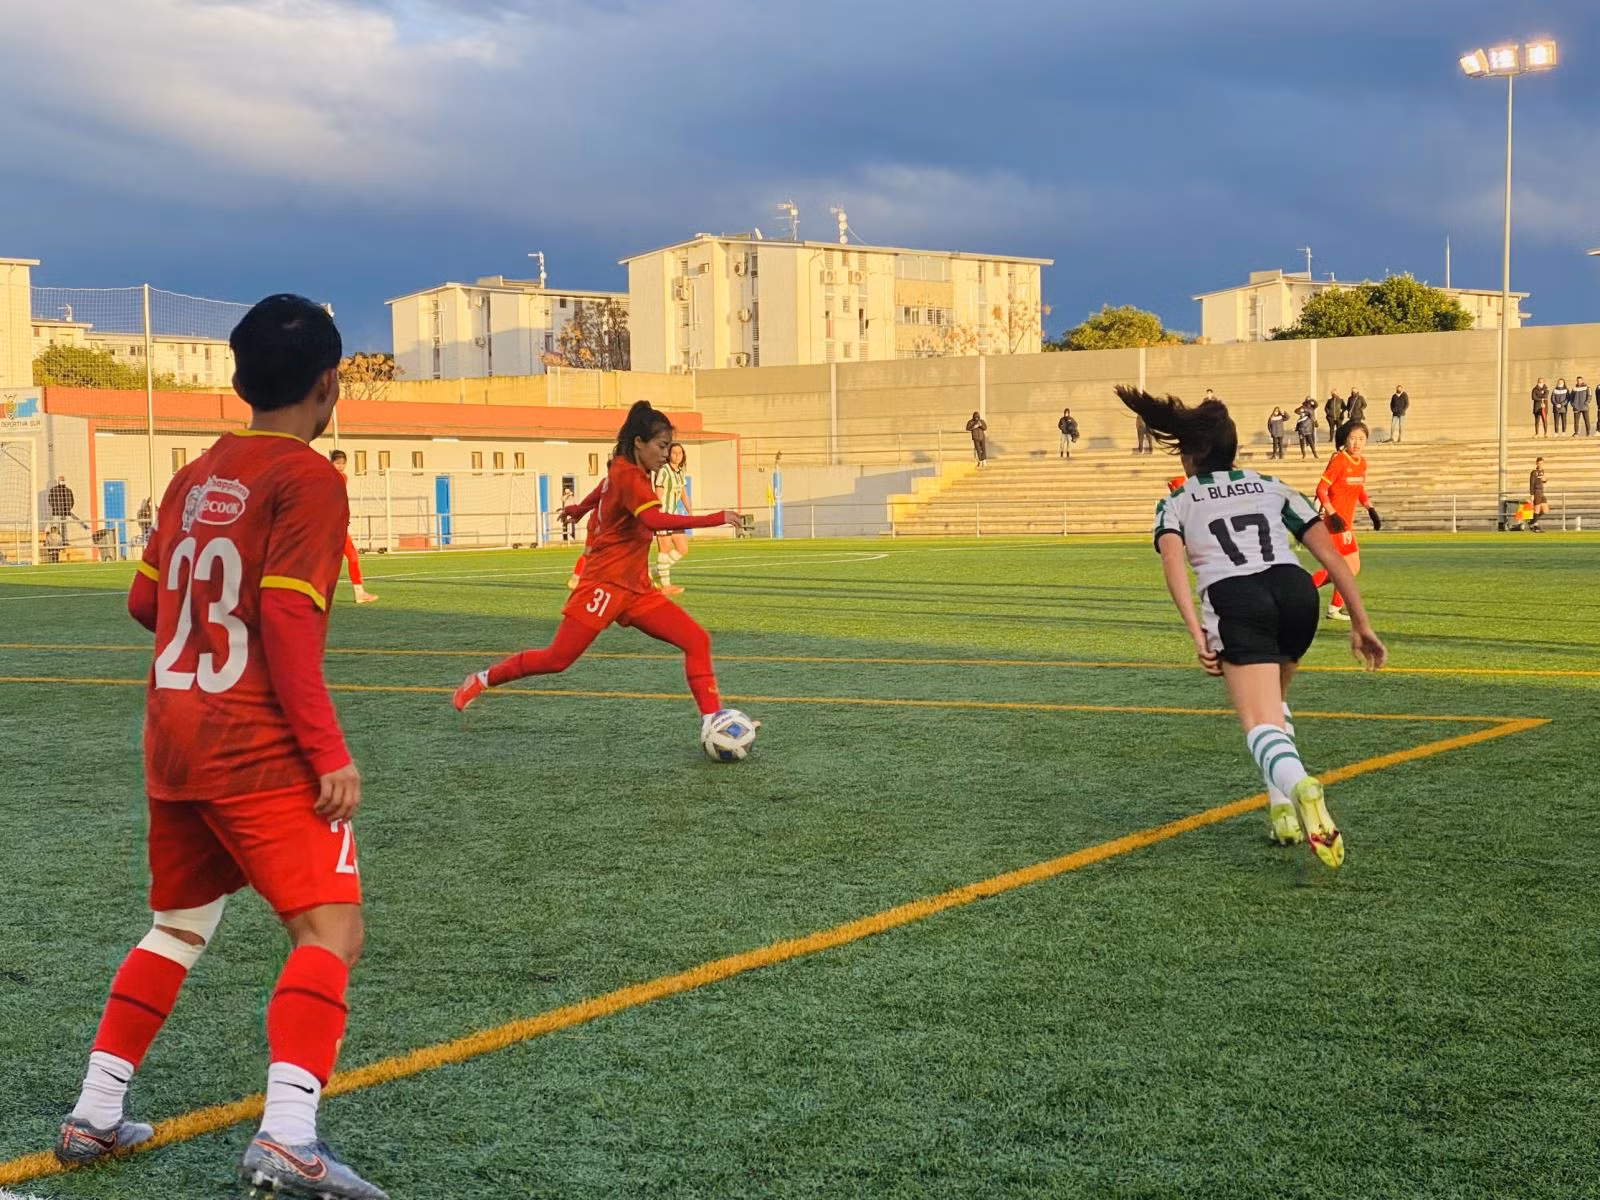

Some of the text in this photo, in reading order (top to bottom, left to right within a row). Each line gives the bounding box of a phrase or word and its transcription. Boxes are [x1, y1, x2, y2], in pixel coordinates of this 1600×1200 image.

[1191, 482, 1265, 502] L. BLASCO
[1208, 513, 1275, 566] 17
[155, 536, 249, 694] 23
[586, 588, 611, 617] 31
